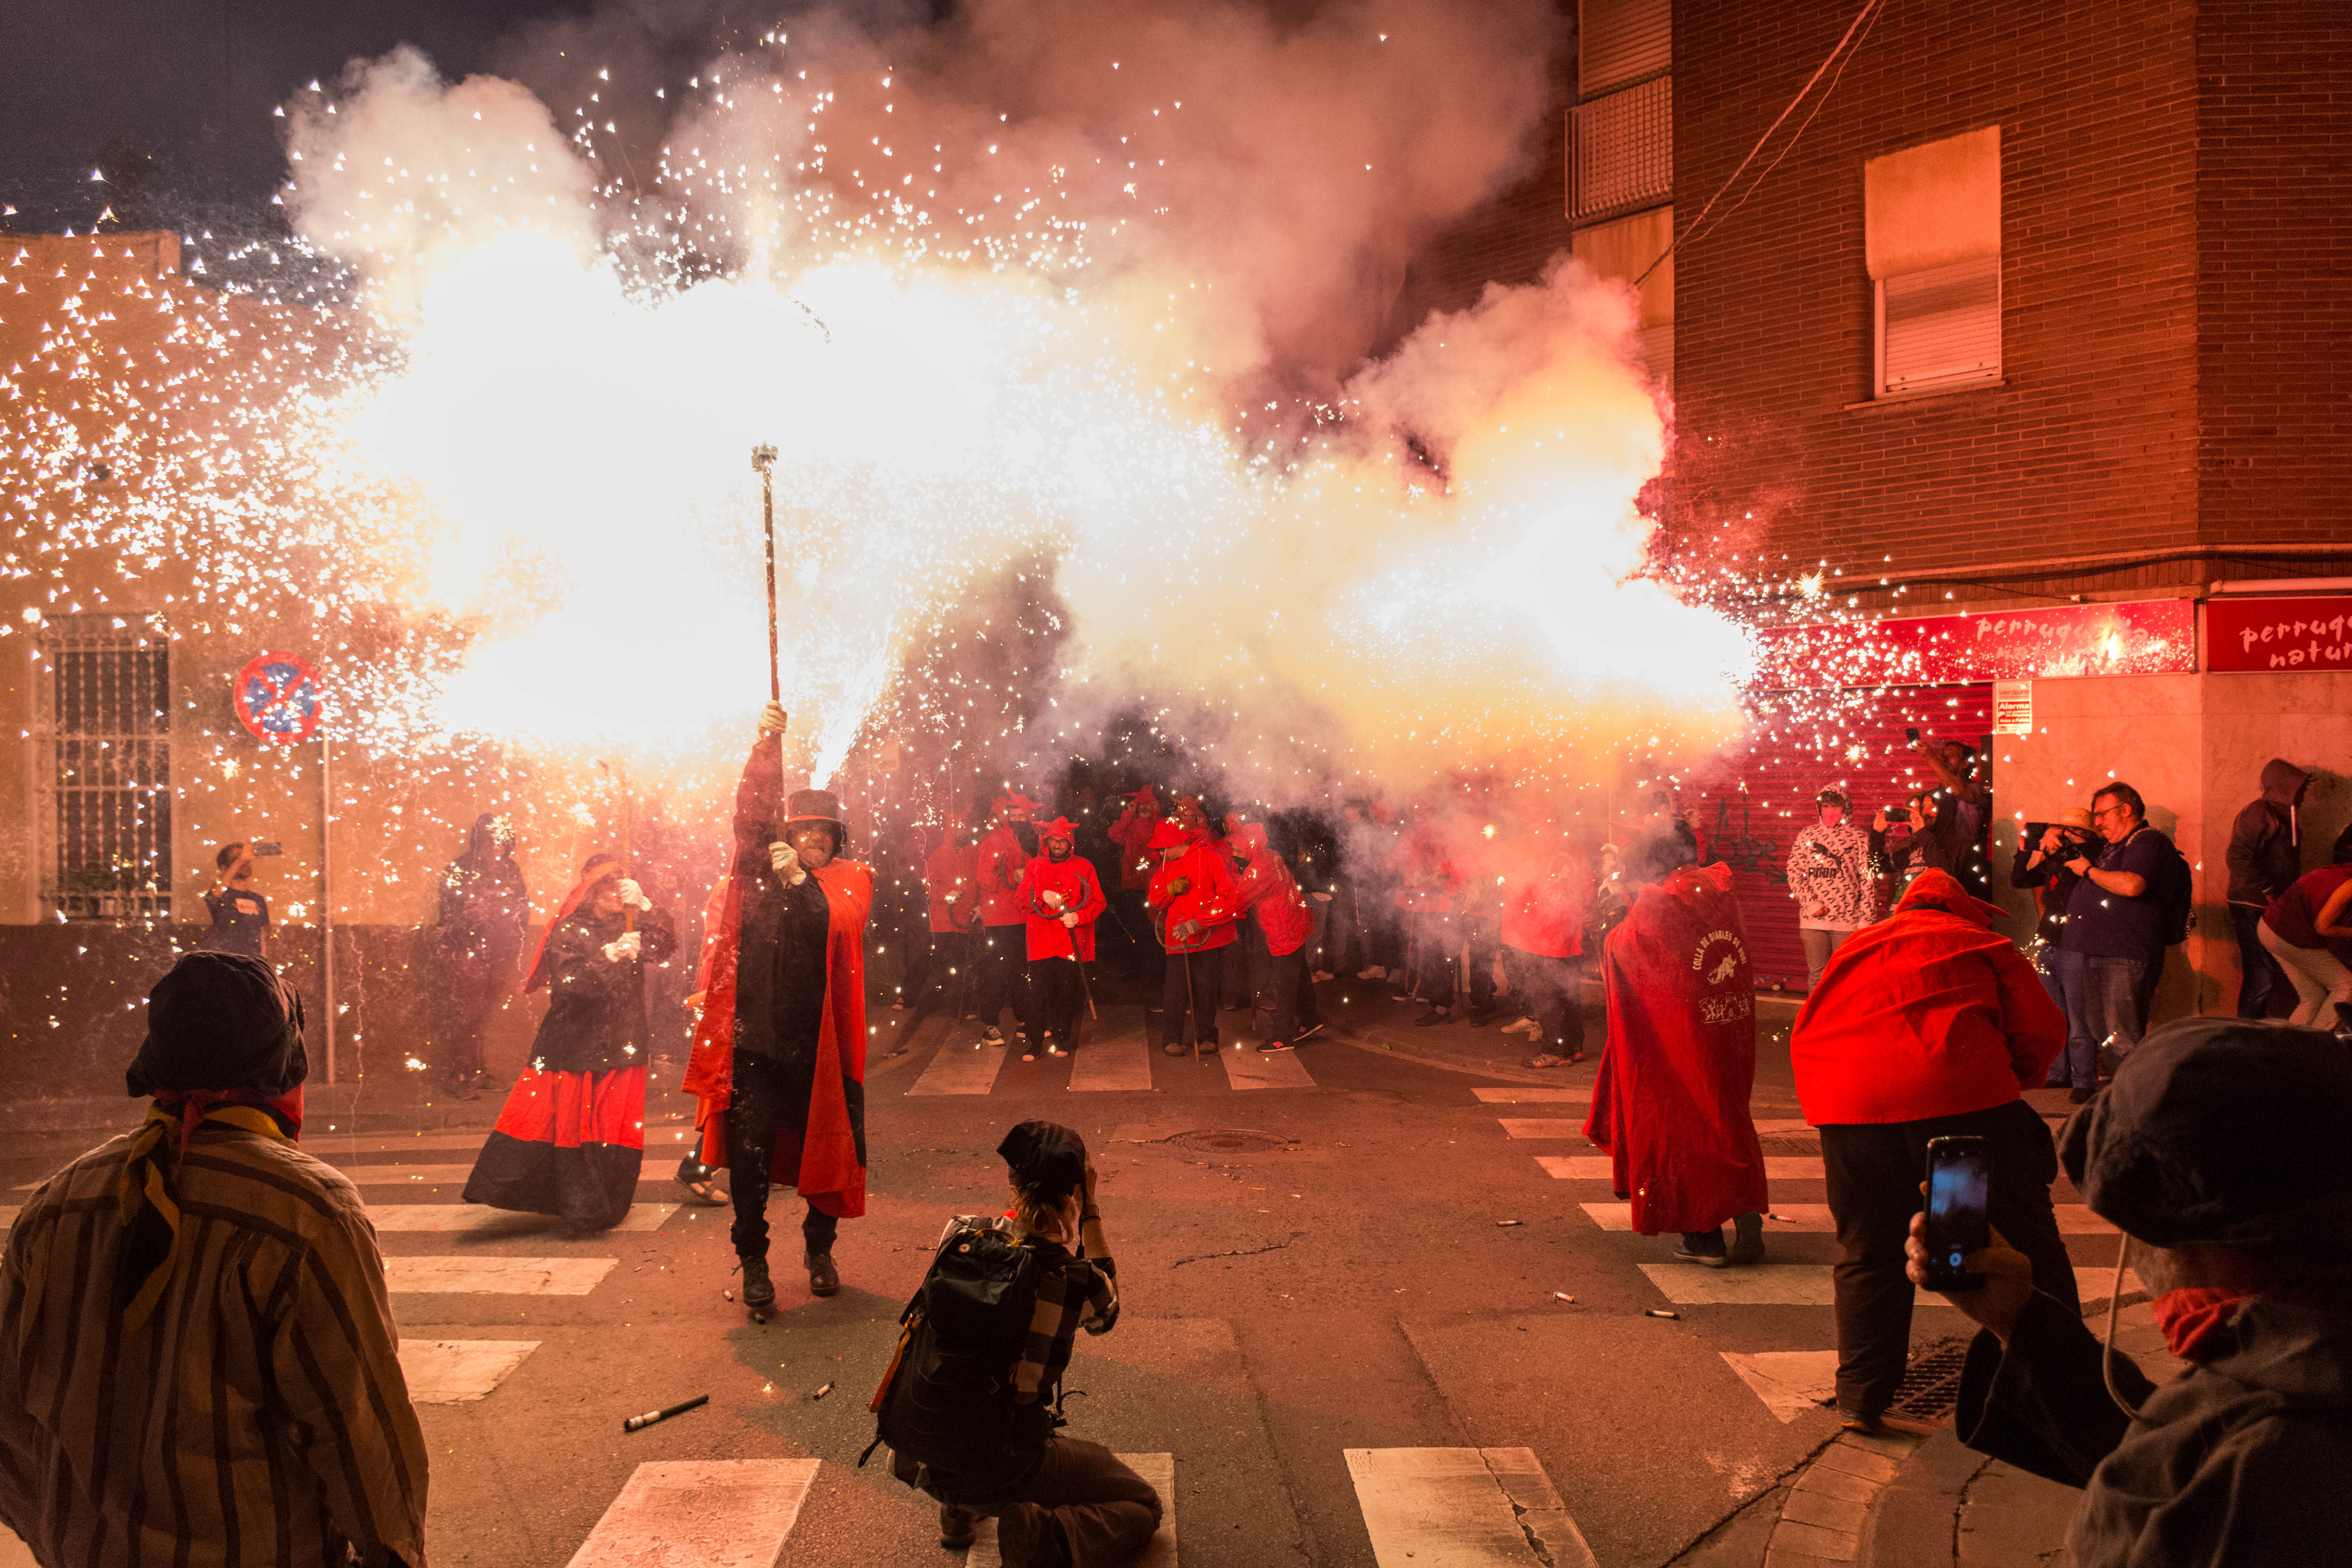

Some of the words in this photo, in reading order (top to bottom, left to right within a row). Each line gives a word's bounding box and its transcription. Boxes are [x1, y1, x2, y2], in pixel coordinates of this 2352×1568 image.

[1693, 947, 1704, 970] COLLA
[1700, 937, 1710, 948] DE
[1708, 930, 1732, 942] DIABLES
[1732, 937, 1740, 948] DE
